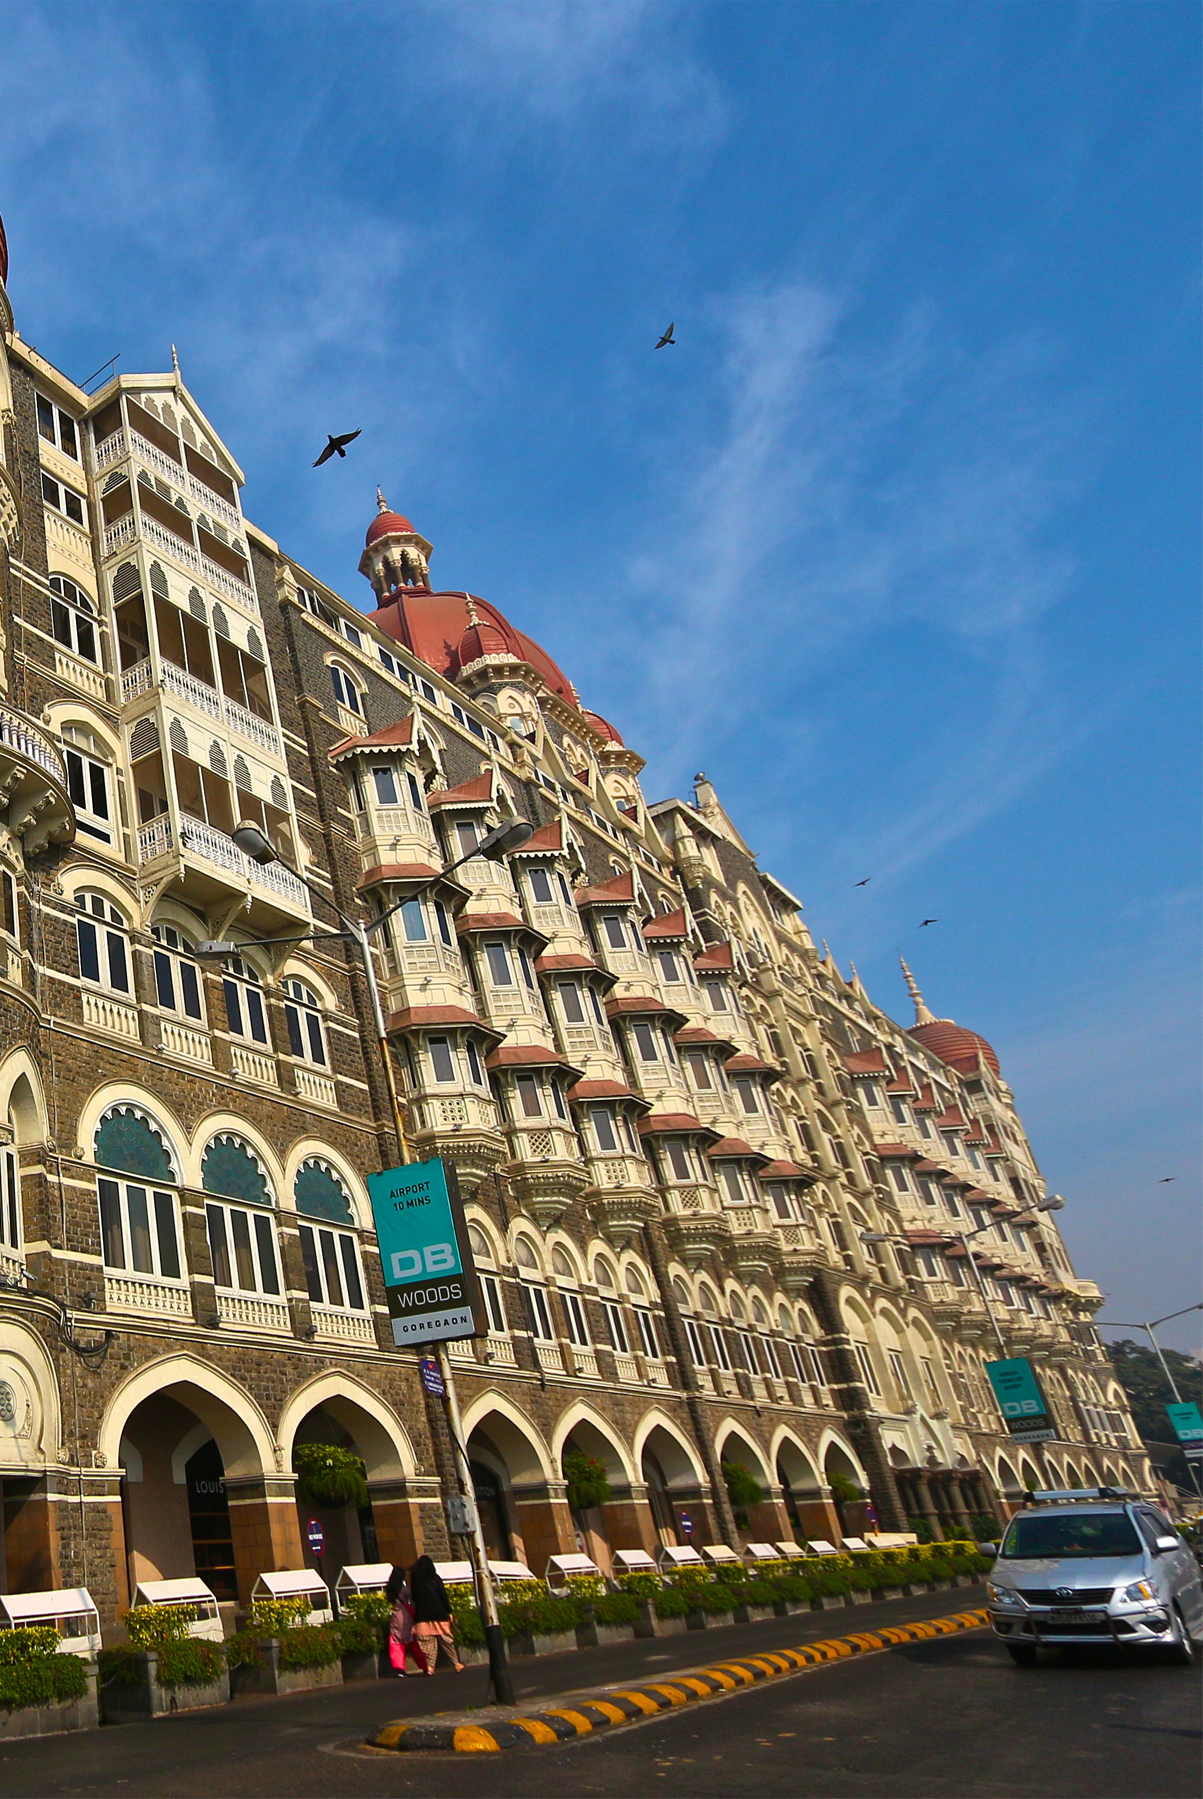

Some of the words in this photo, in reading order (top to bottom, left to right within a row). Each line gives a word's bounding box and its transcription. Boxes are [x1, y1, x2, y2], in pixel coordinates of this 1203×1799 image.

[389, 1181, 431, 1199] AIRPORT
[393, 1201, 405, 1212] 10
[406, 1195, 431, 1210] MINS
[390, 1243, 456, 1279] DB
[397, 1283, 463, 1308] WOODS
[402, 1315, 468, 1333] GOREGAON
[1002, 1399, 1040, 1416] DB
[1009, 1418, 1045, 1430] WOODS
[195, 1481, 224, 1494] LOUIS
